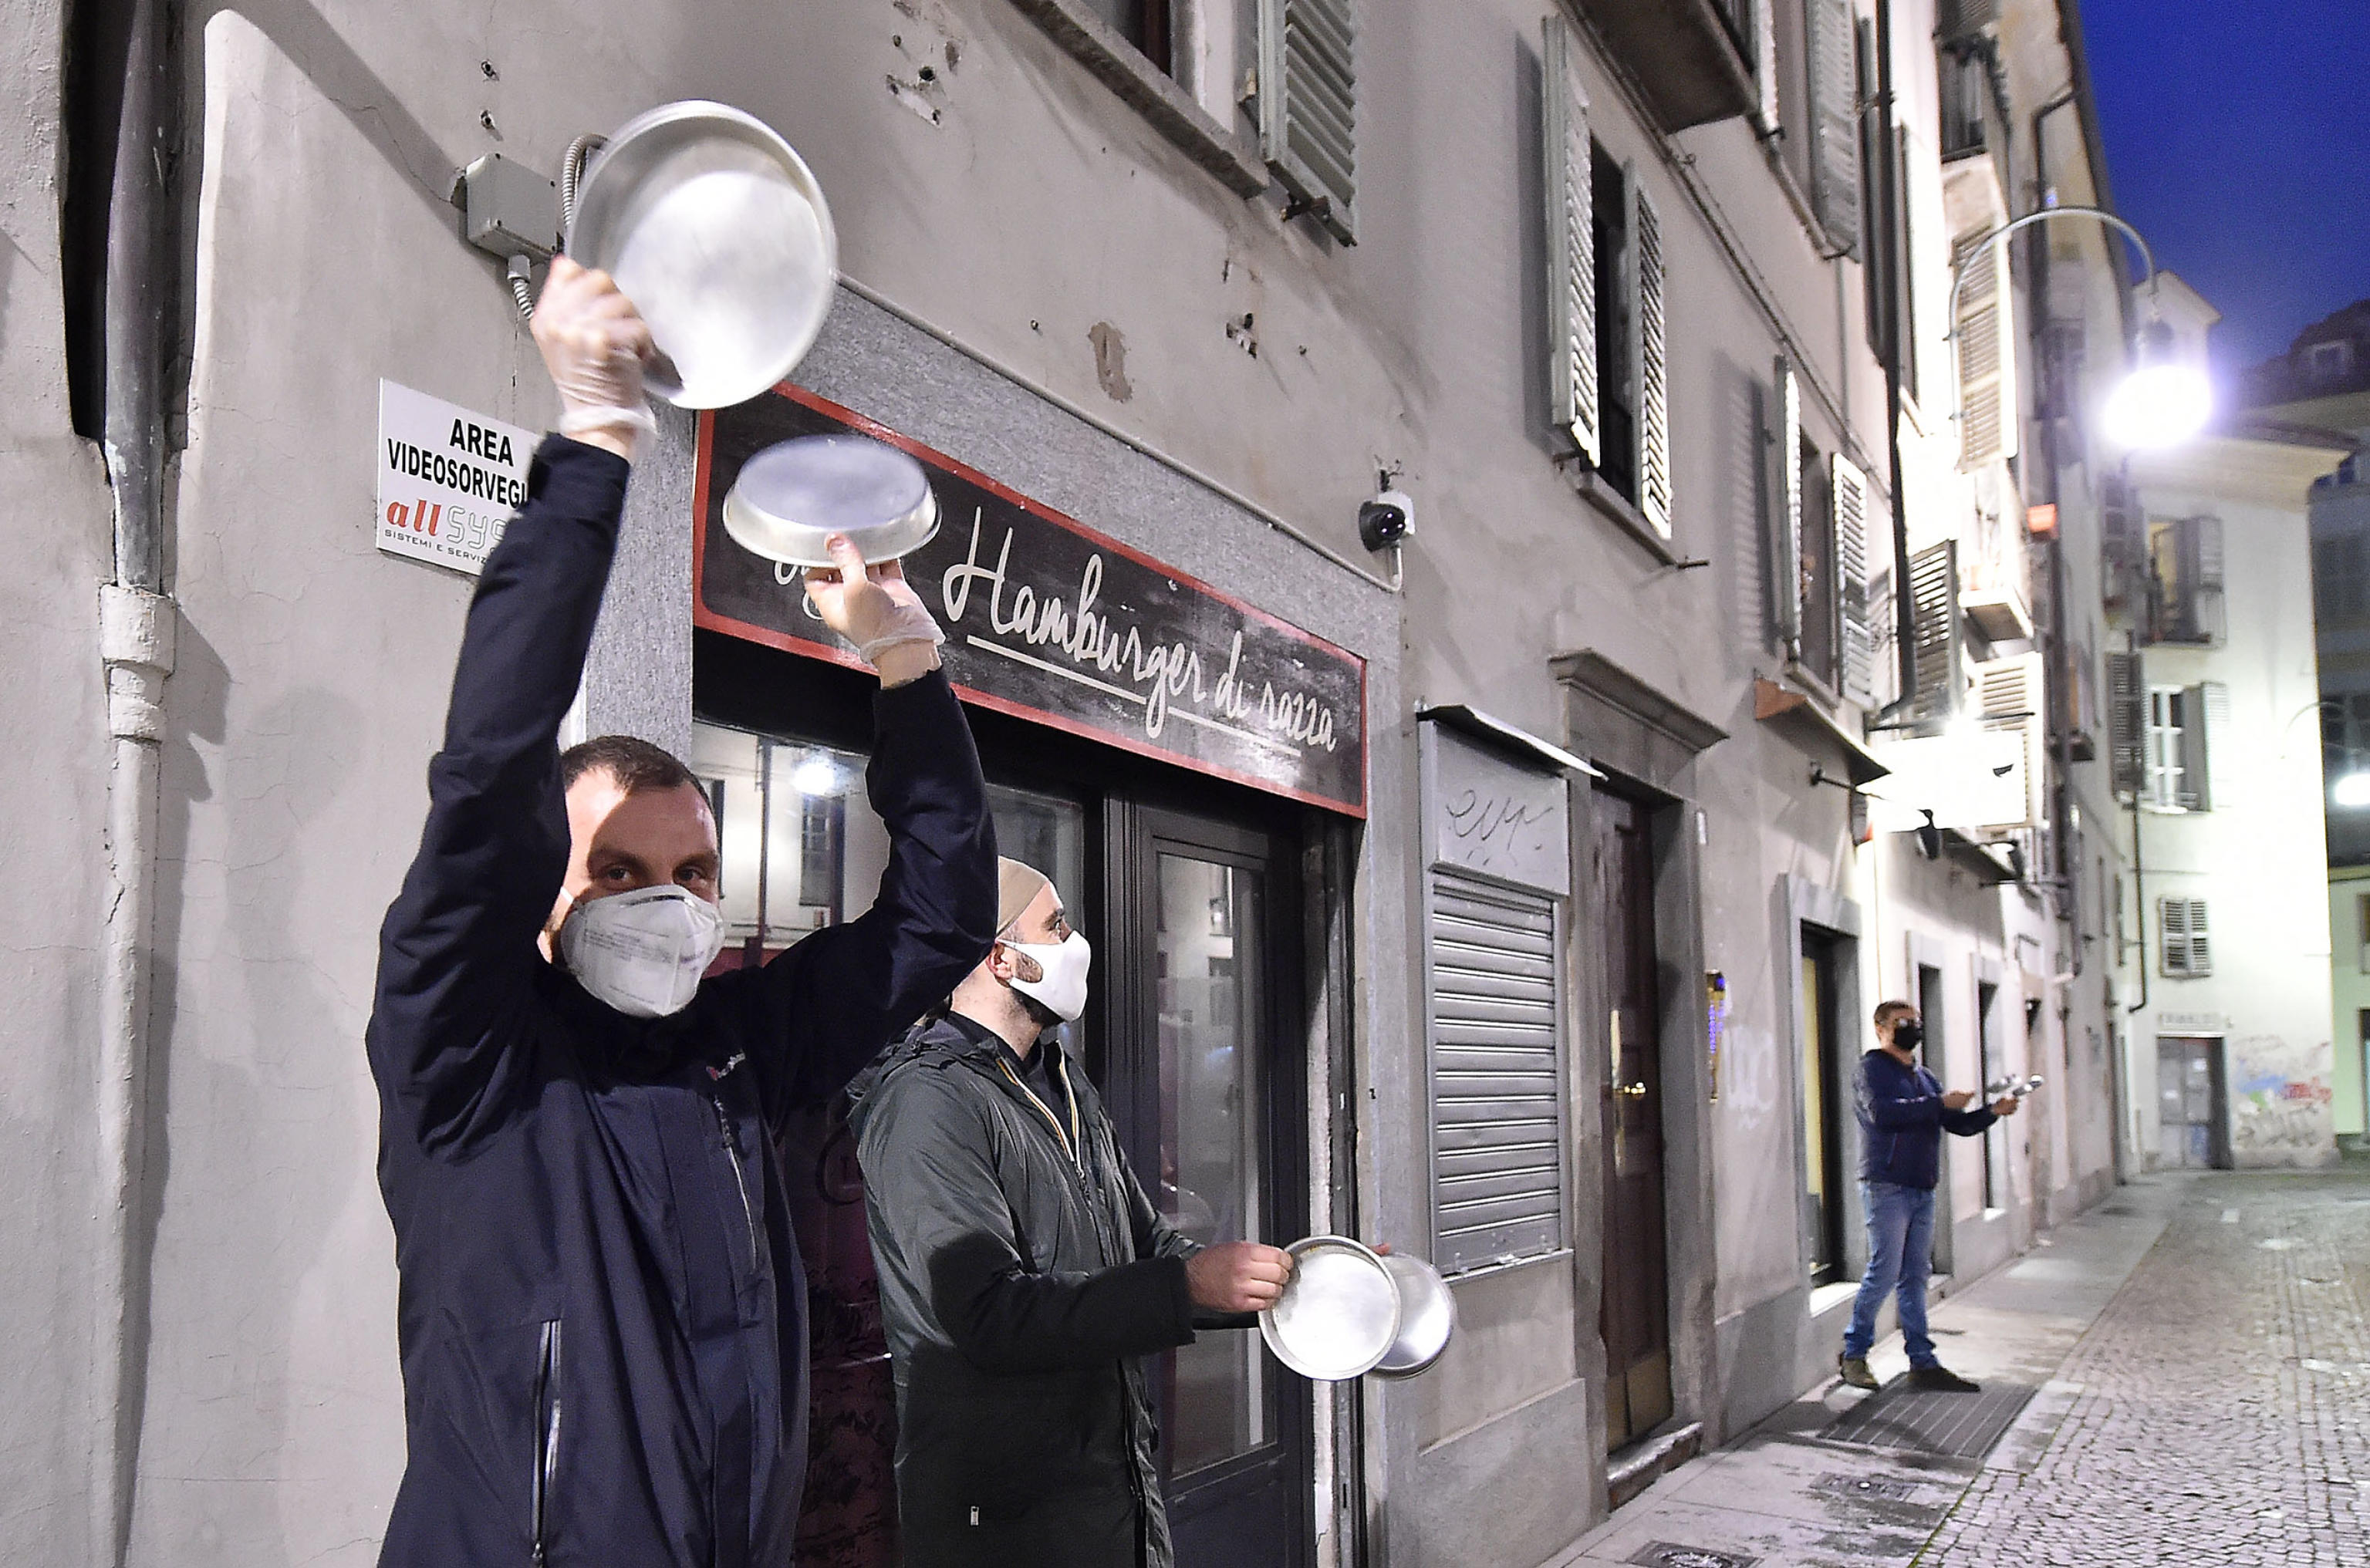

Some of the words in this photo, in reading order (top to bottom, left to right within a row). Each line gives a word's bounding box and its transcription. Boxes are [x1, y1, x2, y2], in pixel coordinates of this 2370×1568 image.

[450, 418, 514, 467] AREA
[384, 529, 432, 549] SISTEMI
[437, 544, 443, 552] E
[943, 505, 1207, 739] Hamburger
[1214, 629, 1251, 719] di
[1259, 680, 1337, 752] razza
